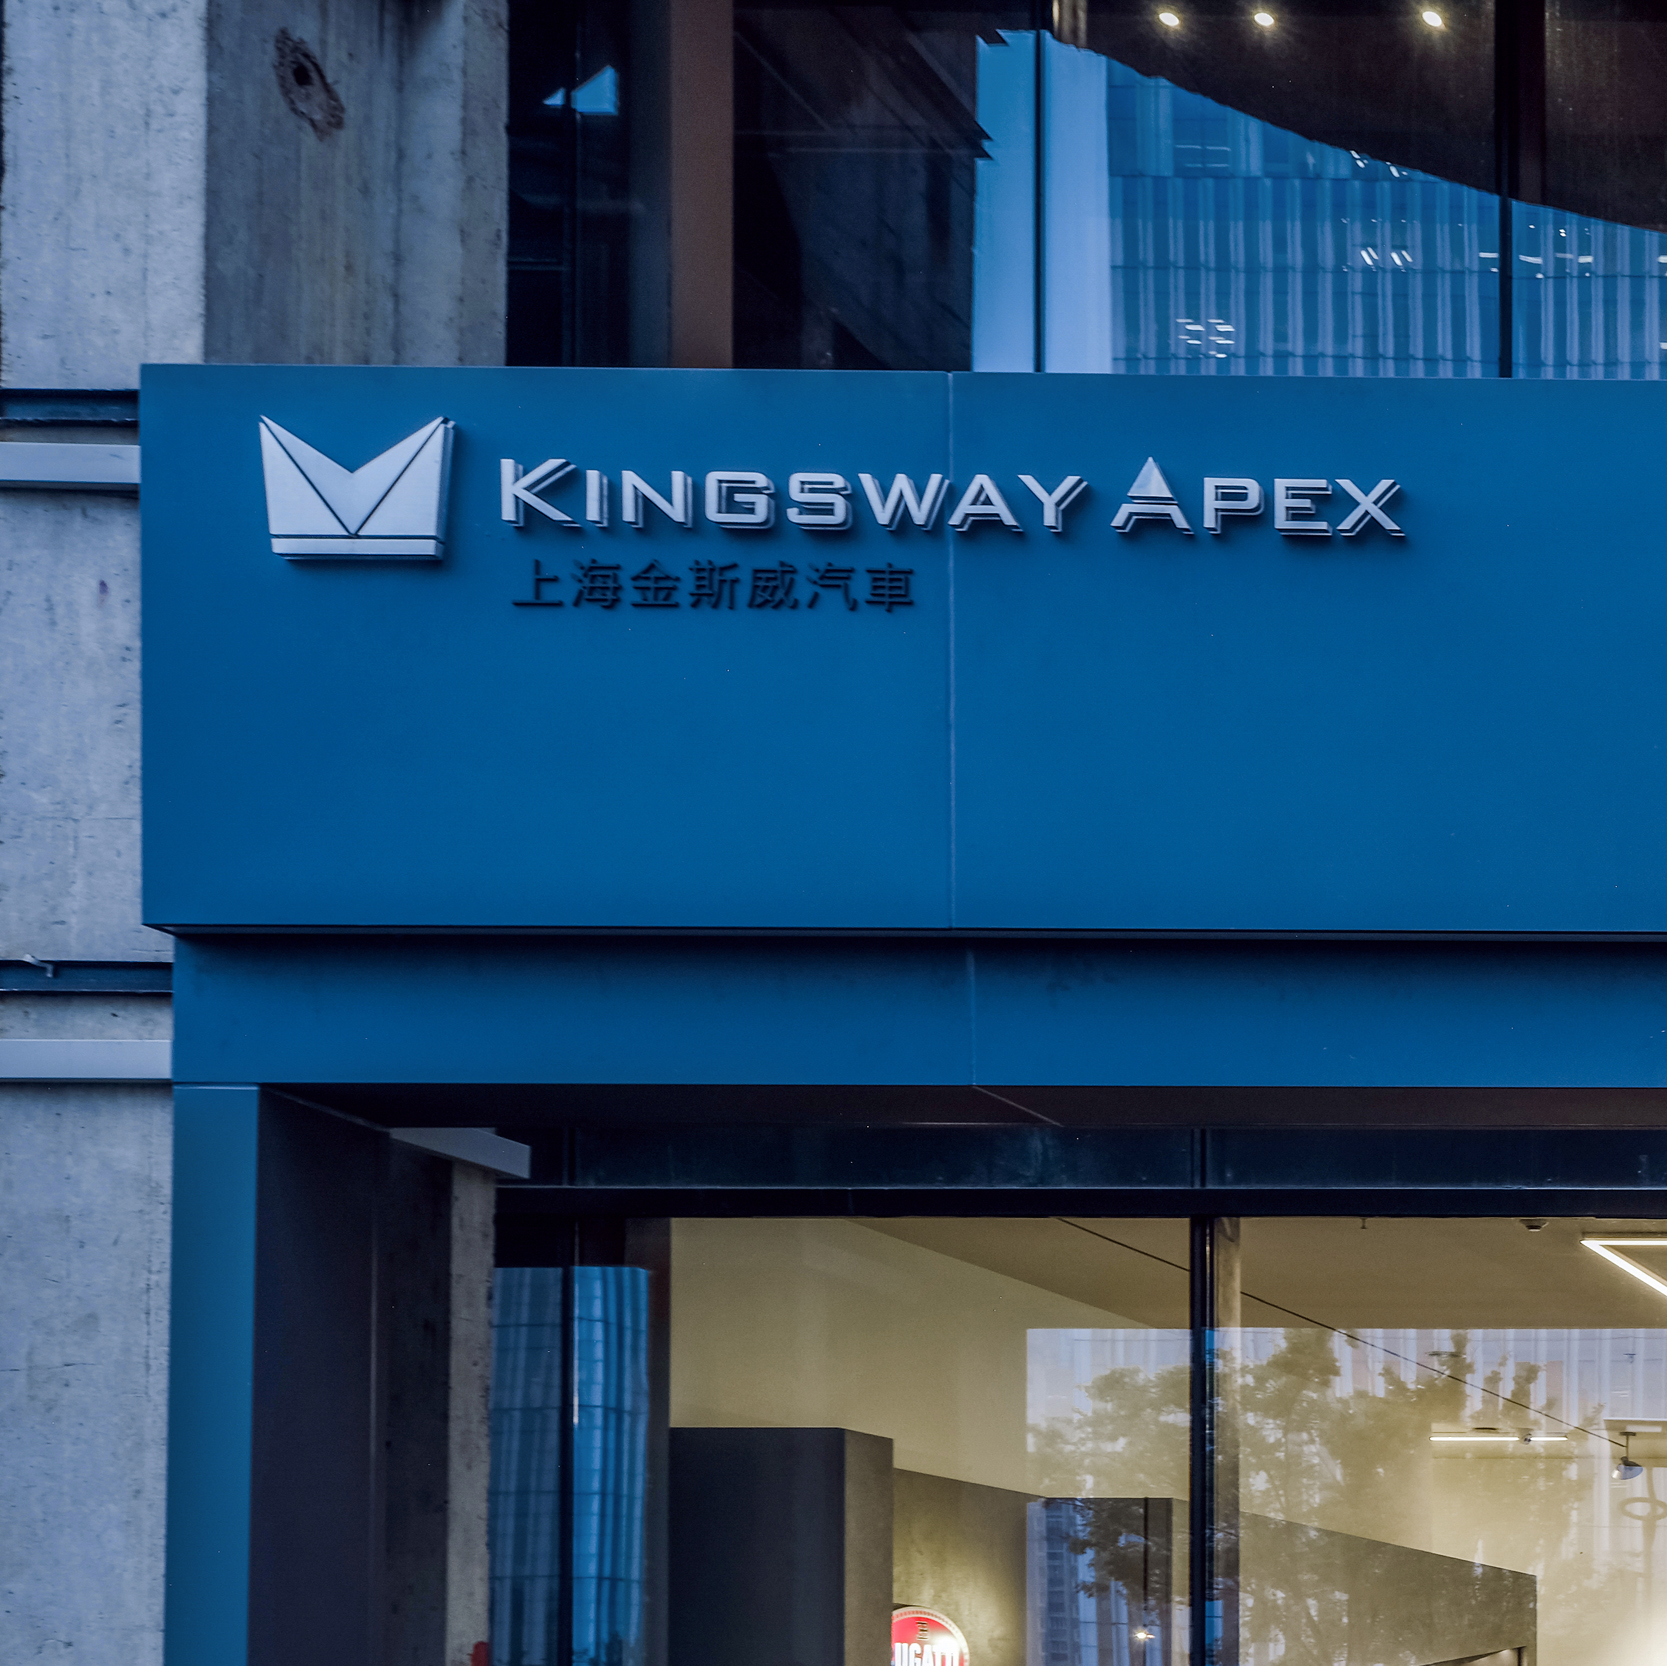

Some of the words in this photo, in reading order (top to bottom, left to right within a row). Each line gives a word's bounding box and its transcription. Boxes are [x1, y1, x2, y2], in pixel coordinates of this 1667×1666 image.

[500, 458, 1088, 533] KINGSWAY
[1110, 456, 1405, 536] APEX
[512, 558, 915, 613] 上海金斯威汽車
